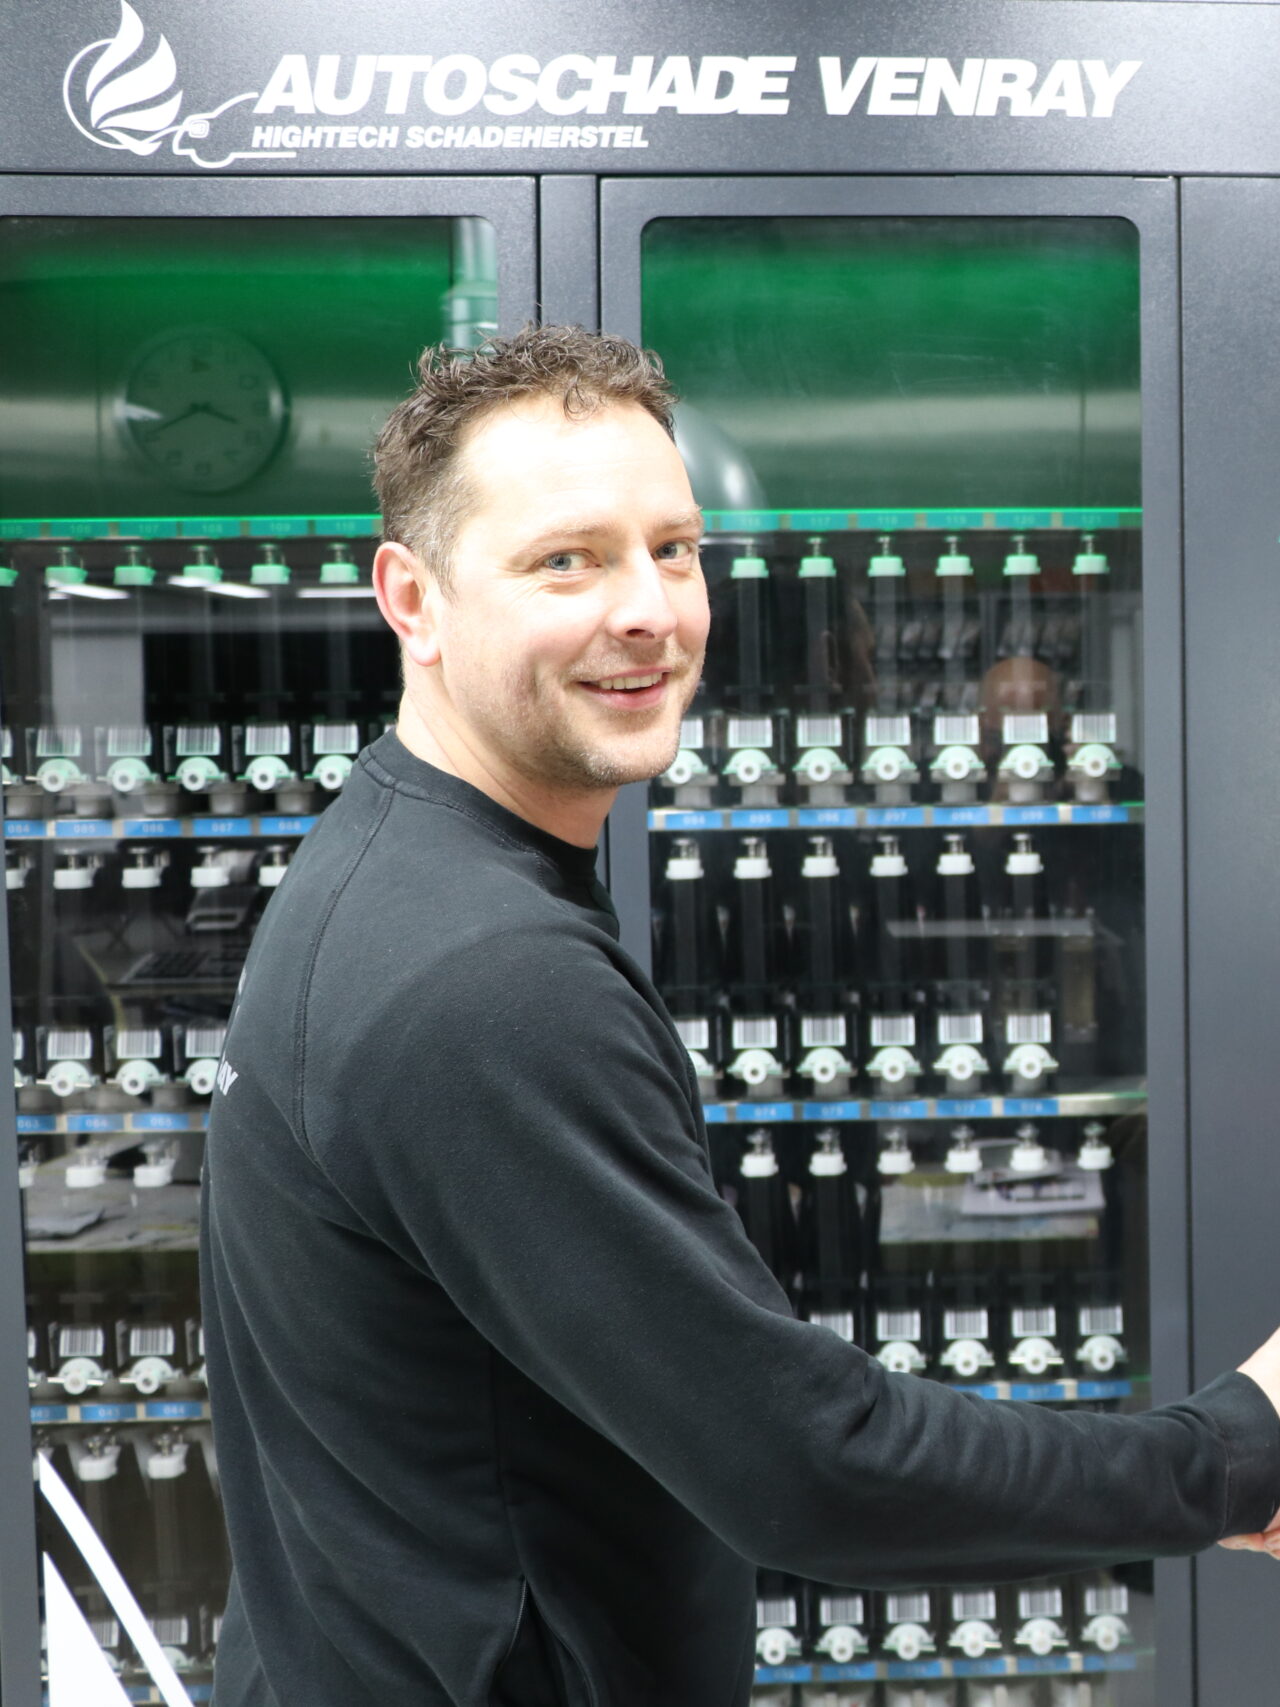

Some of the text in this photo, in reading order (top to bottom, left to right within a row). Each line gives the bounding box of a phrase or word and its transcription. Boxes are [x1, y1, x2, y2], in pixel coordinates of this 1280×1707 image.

[253, 53, 1144, 118] AUTOSCHADE VENRAY
[251, 125, 650, 149] HIGHTECH SCHADEHERSTEL
